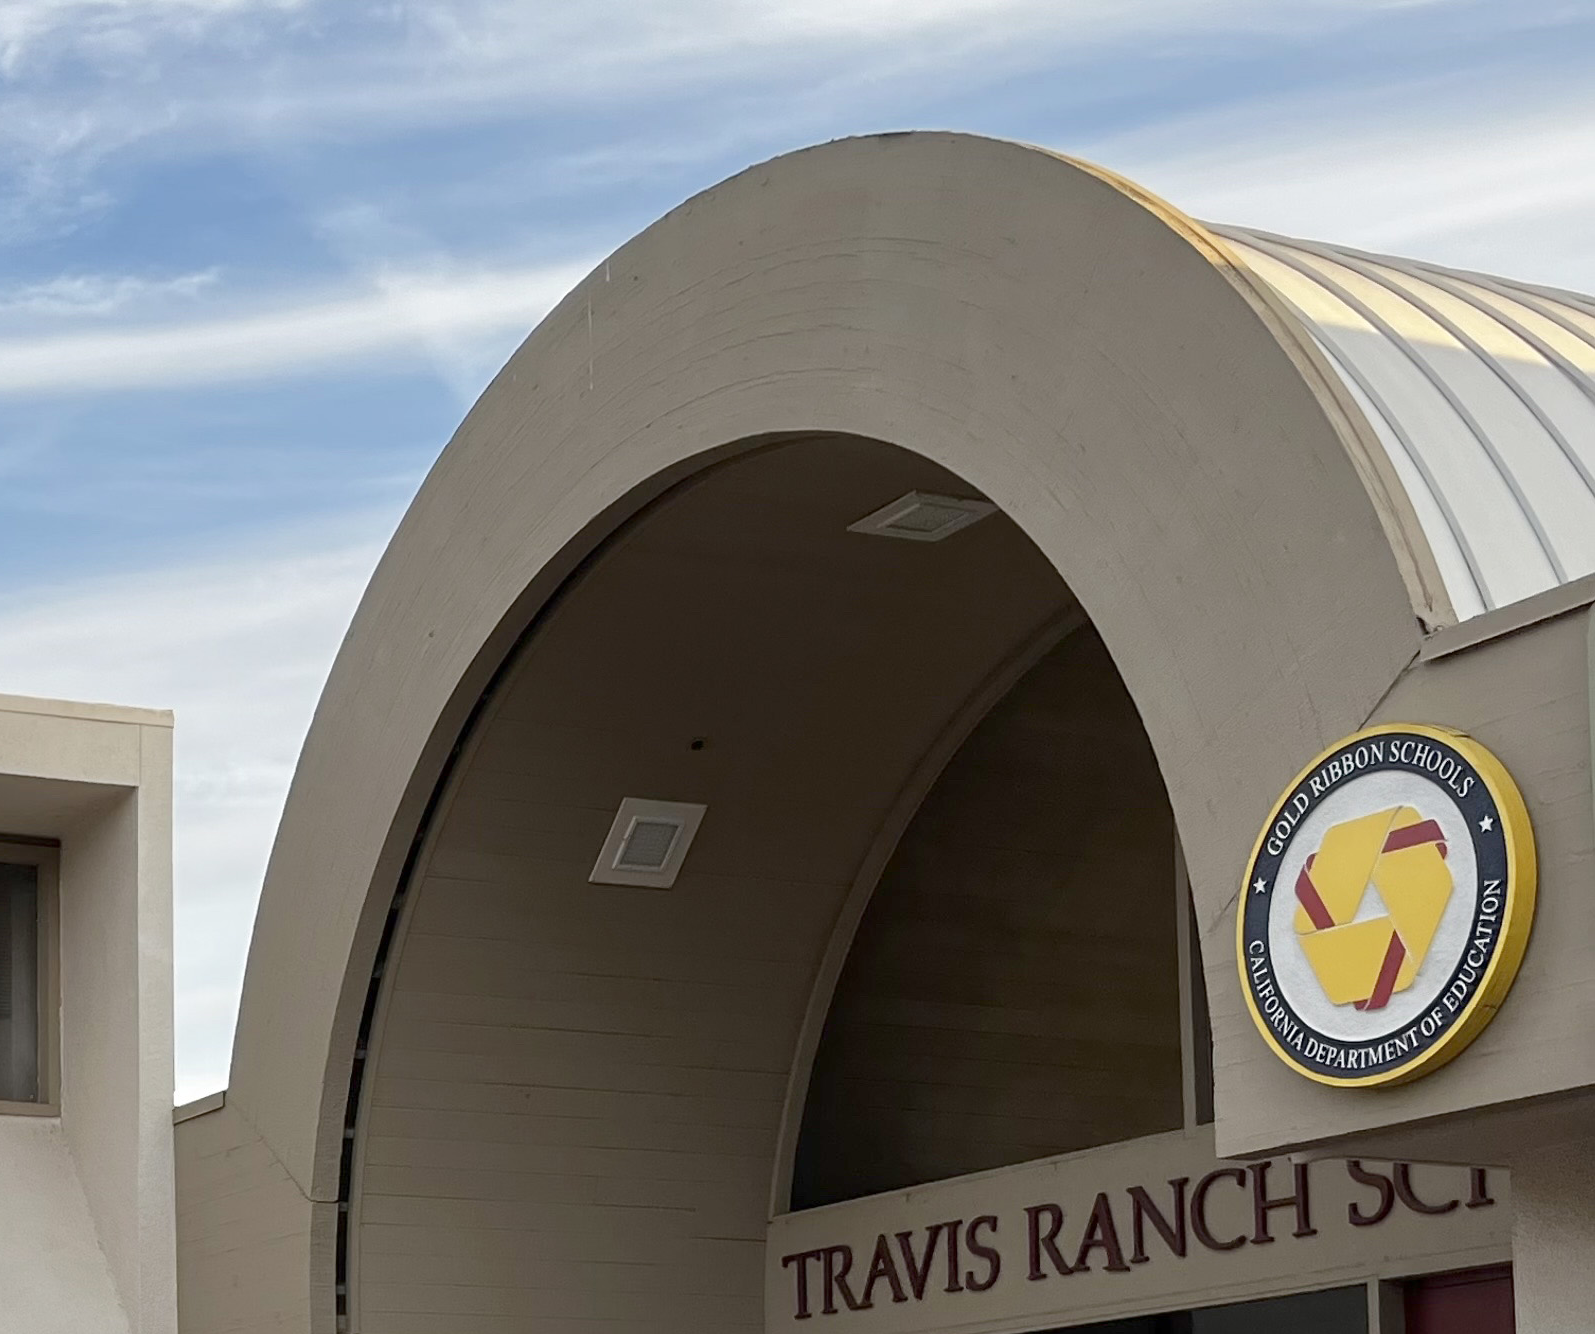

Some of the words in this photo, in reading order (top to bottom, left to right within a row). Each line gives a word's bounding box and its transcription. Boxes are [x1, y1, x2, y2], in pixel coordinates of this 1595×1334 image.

[1267, 793, 1310, 857] GOLD
[1309, 742, 1385, 798] RIBBON
[1389, 740, 1476, 799] SCHOOLS
[1248, 939, 1305, 1051] CALIFORNIA
[1303, 1029, 1420, 1069] DEPARTMENT
[1420, 1007, 1445, 1037] OF
[1445, 878, 1503, 1013] EDUCATION
[782, 1215, 1001, 1321] TRAVIS
[1023, 1159, 1318, 1281] RANCH
